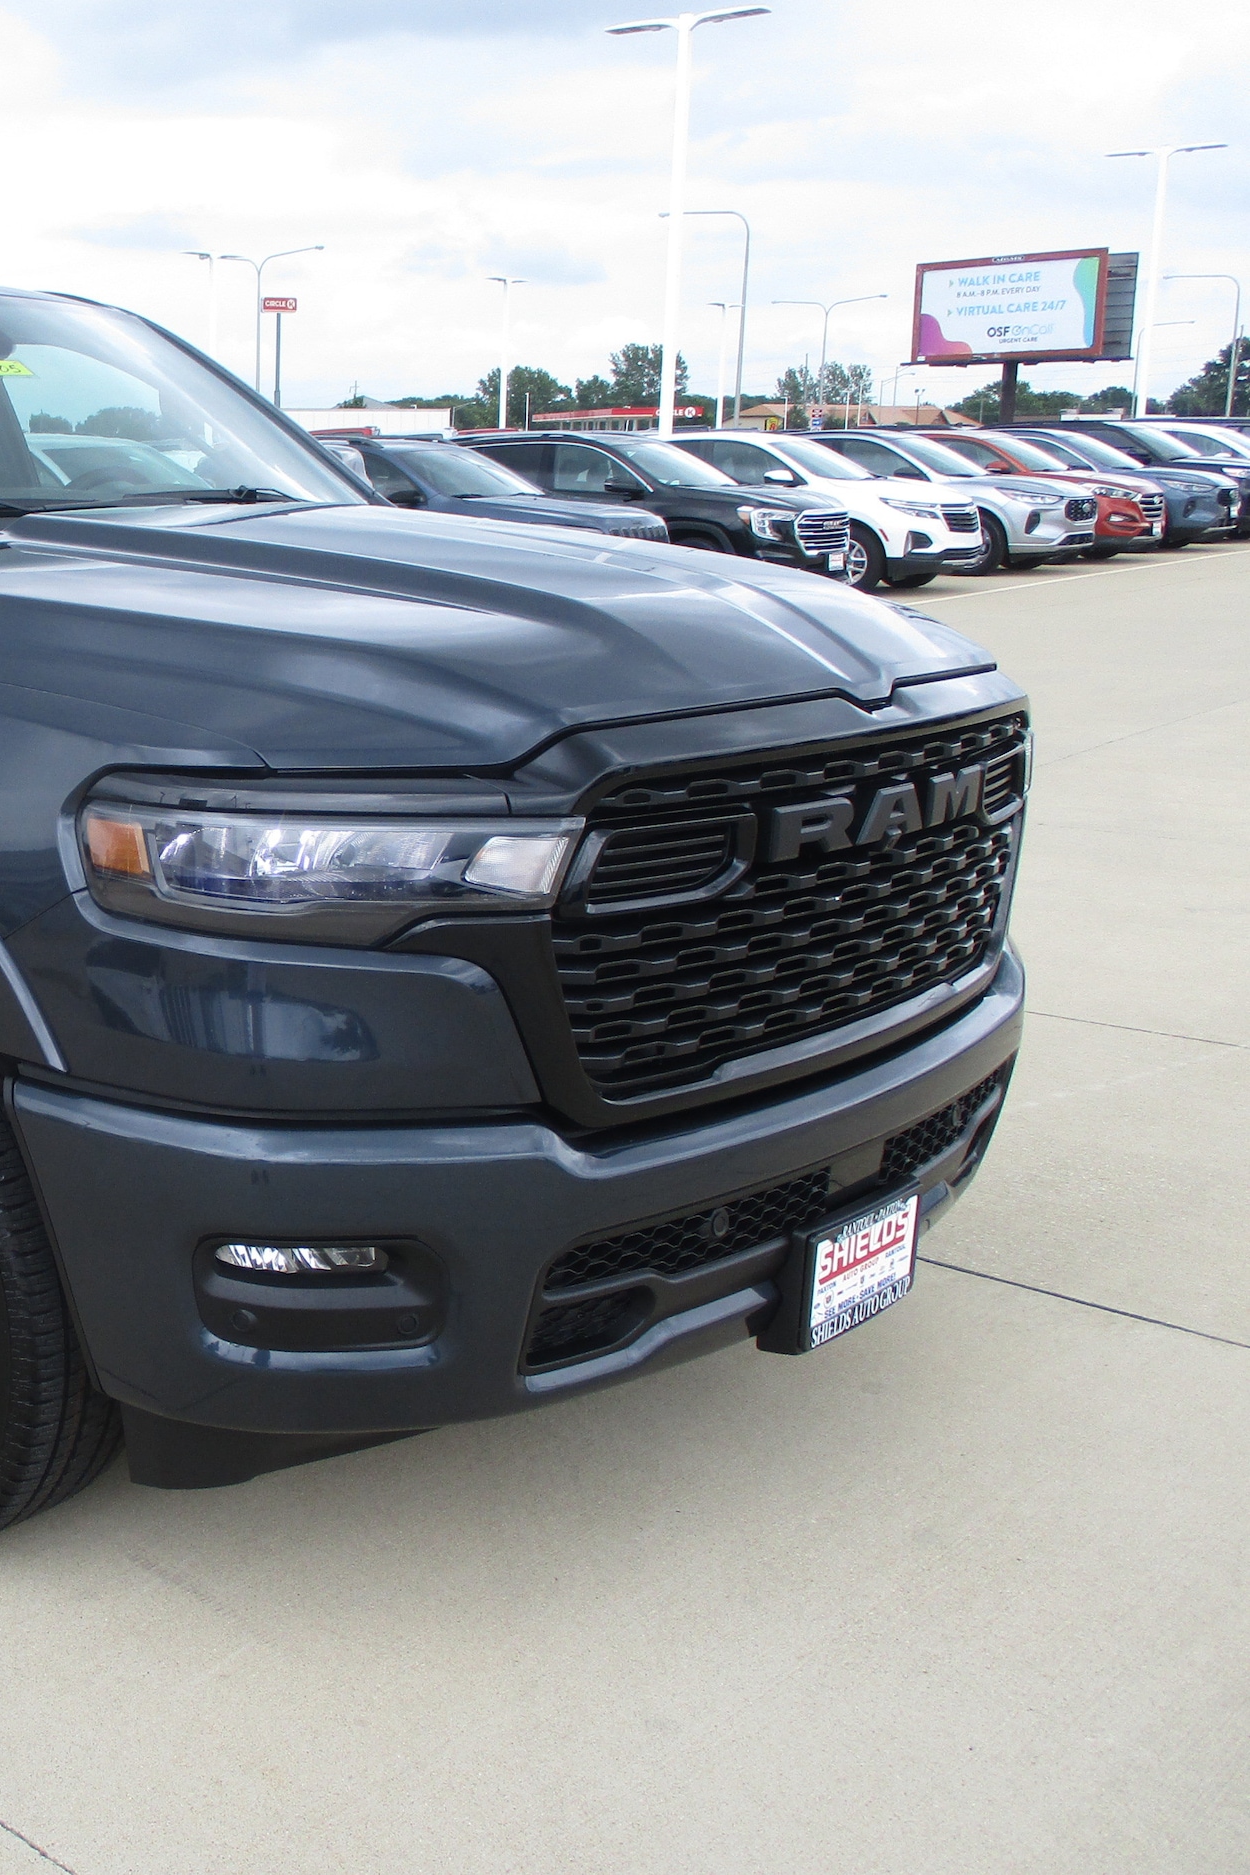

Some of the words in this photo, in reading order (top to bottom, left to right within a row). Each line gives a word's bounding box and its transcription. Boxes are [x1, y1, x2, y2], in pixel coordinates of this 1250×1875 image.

[957, 276, 991, 287] WALK
[993, 274, 1006, 284] IN
[1008, 271, 1041, 283] CARE
[1001, 286, 1025, 295] EVERY
[1026, 285, 1041, 293] DAY
[956, 304, 1004, 316] VIRTUAL
[1006, 302, 1039, 313] CARE
[1040, 300, 1066, 312] 24/7
[986, 326, 1010, 338] OSF
[768, 763, 985, 863] RAM
[820, 1208, 911, 1277] SHIELDS
[843, 1268, 858, 1281] AUTO
[860, 1257, 879, 1273] GROUP
[817, 1281, 837, 1294] PAXTON
[811, 1307, 851, 1348] SHIELDS
[852, 1295, 879, 1326] AUTO
[880, 1275, 911, 1309] GROUP
[824, 1307, 836, 1319] SEE
[860, 1284, 875, 1299] SAVE
